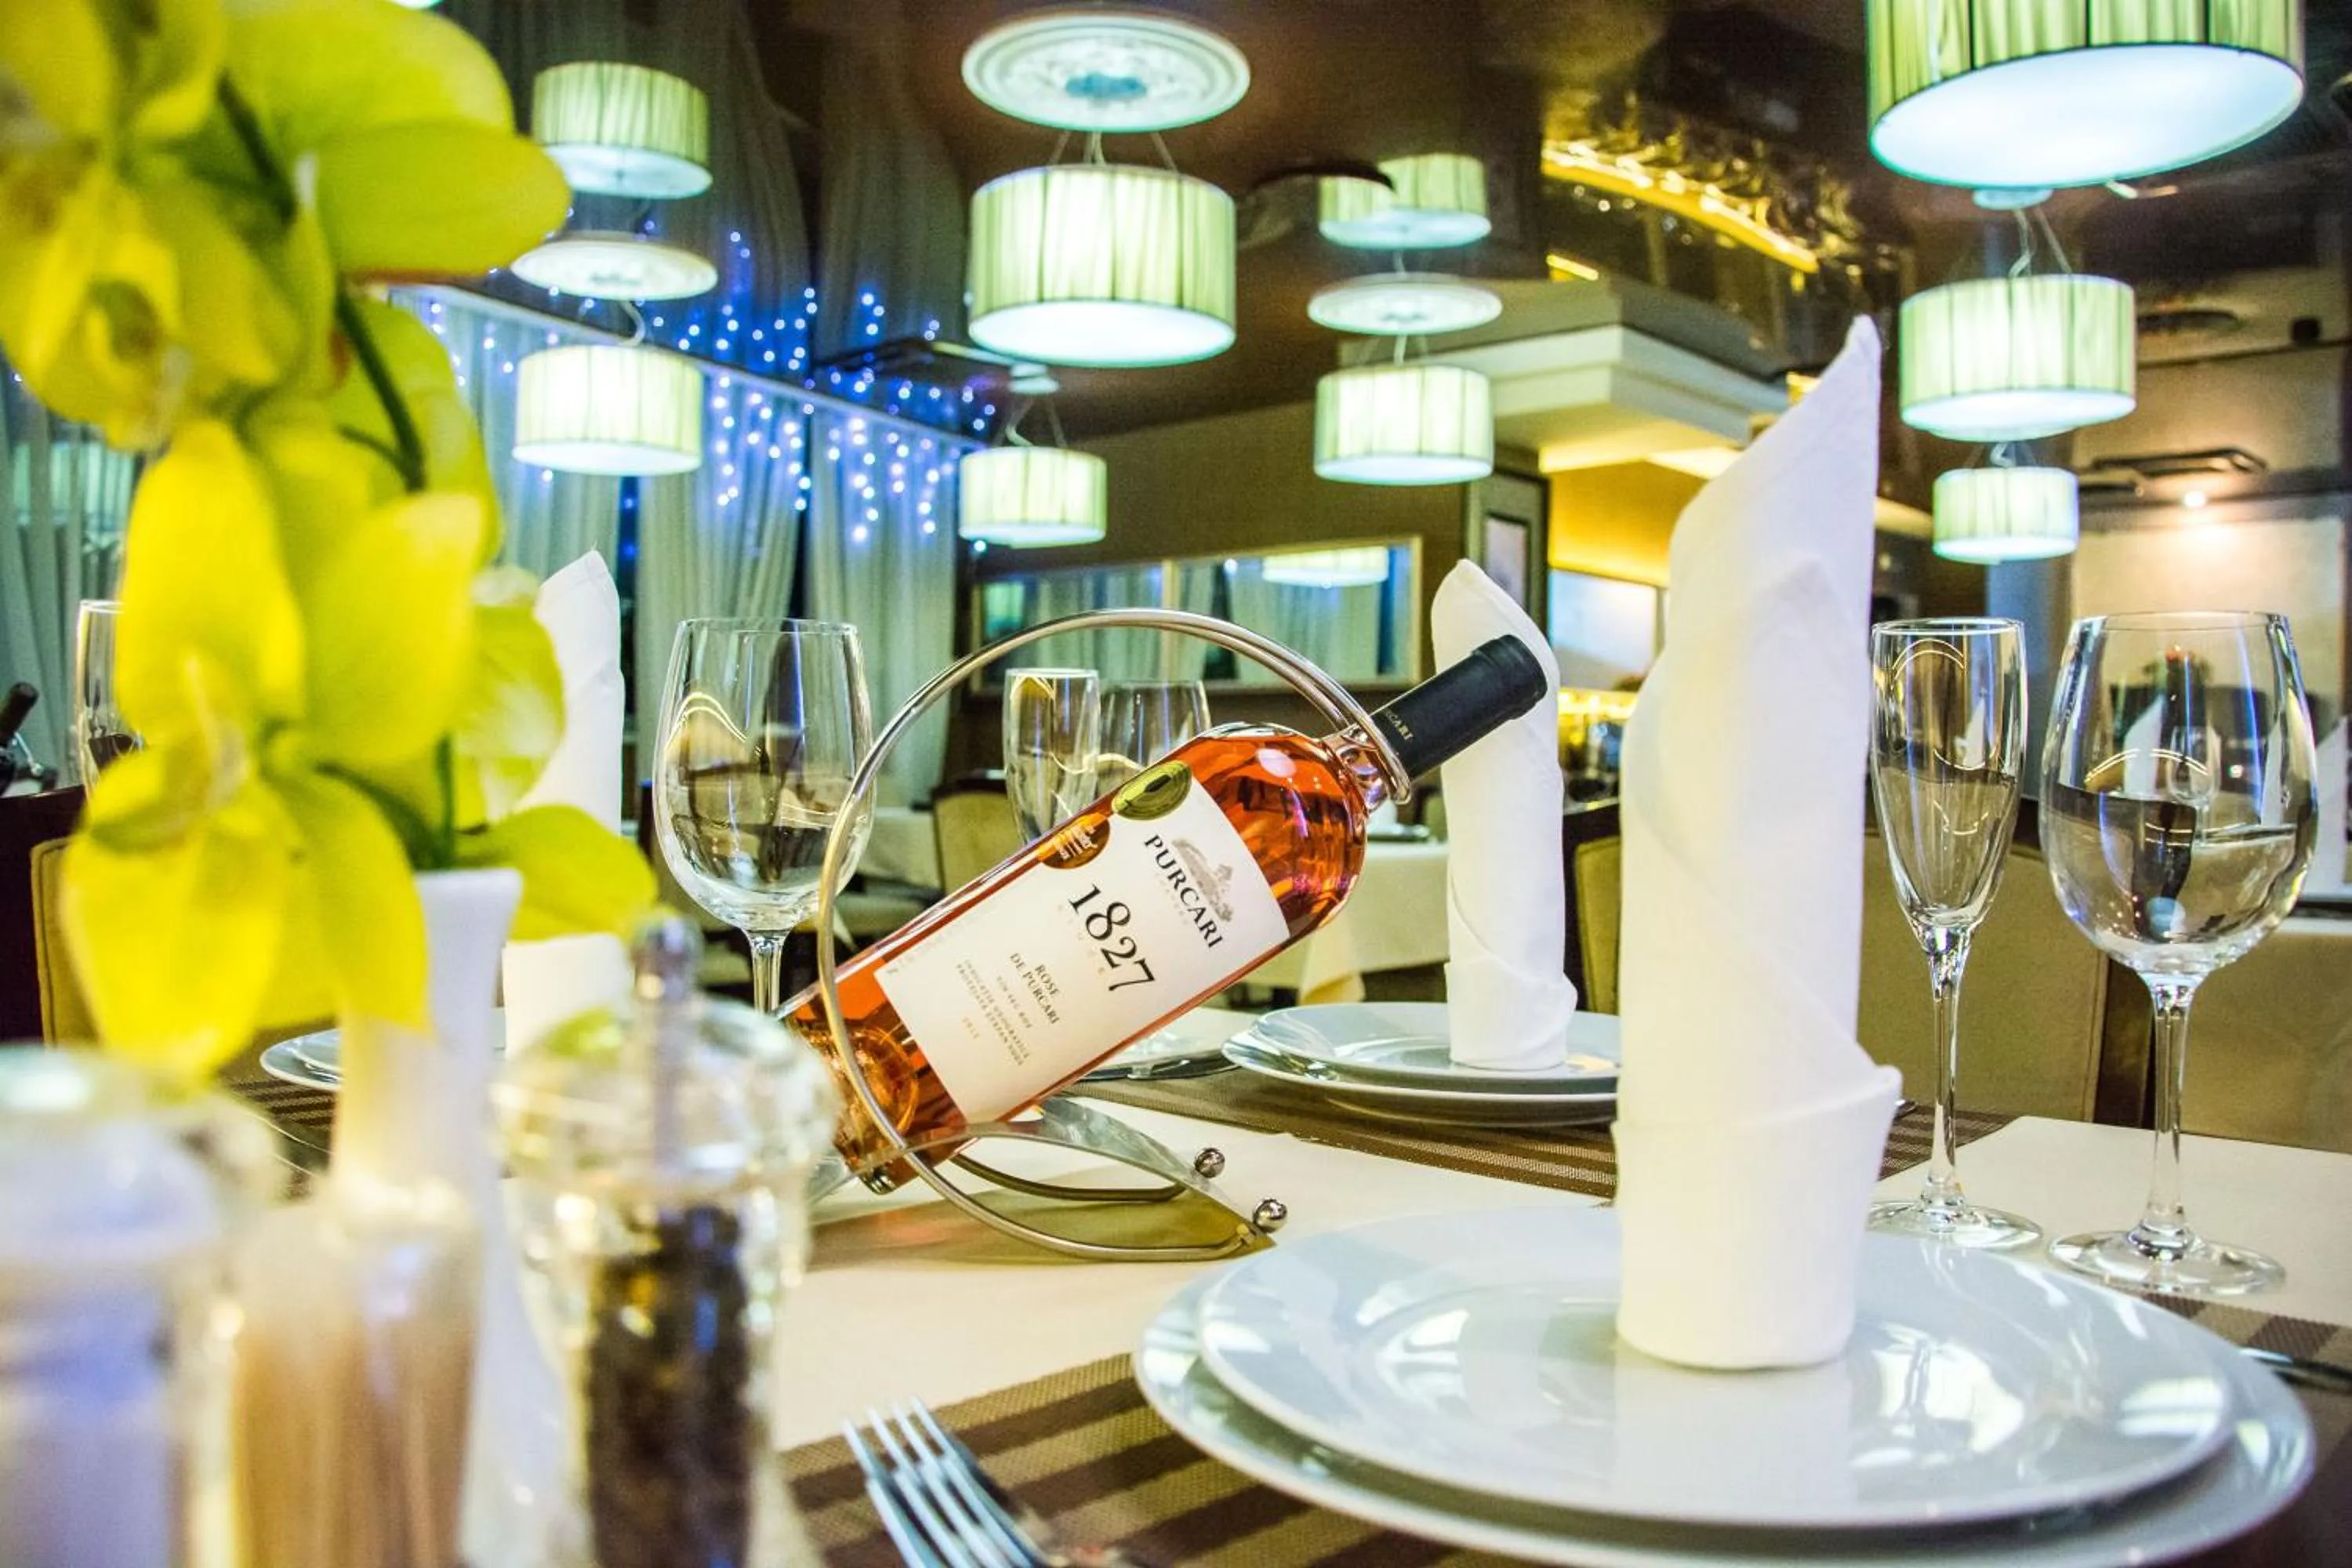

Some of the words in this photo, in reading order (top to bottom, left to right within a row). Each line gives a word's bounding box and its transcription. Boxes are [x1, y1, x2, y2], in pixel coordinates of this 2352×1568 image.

[1068, 884, 1155, 991] 1827
[1143, 833, 1224, 949] PURCARI
[1009, 952, 1025, 970] DE
[1021, 971, 1061, 1025] PURCARI
